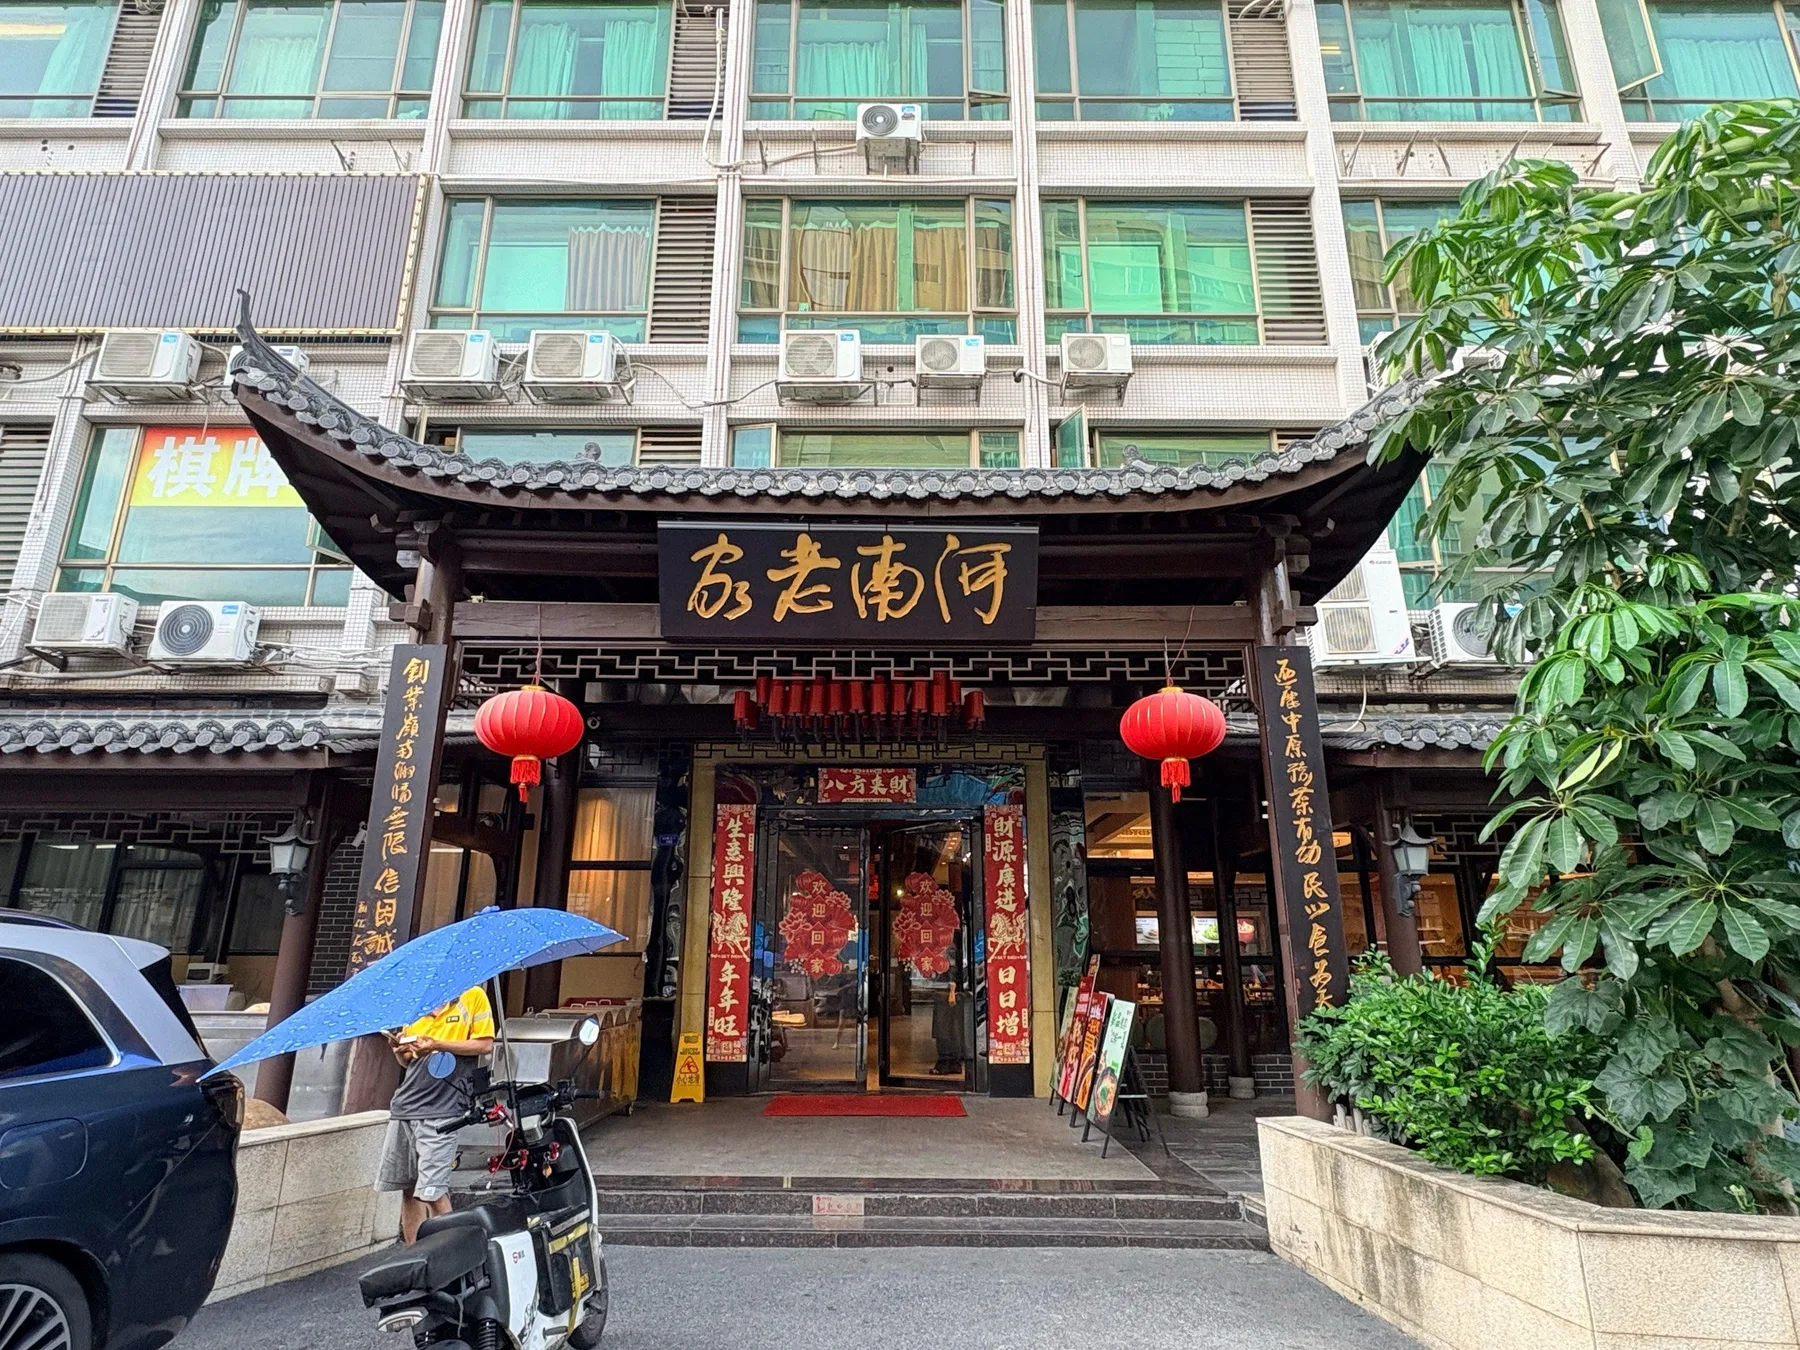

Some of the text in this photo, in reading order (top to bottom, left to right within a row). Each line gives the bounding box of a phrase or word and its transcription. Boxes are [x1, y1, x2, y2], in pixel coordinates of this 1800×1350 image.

[147, 436, 290, 498] 棋牌
[810, 880, 827, 973] 欢迎回家
[919, 880, 934, 973] 欢迎回家
